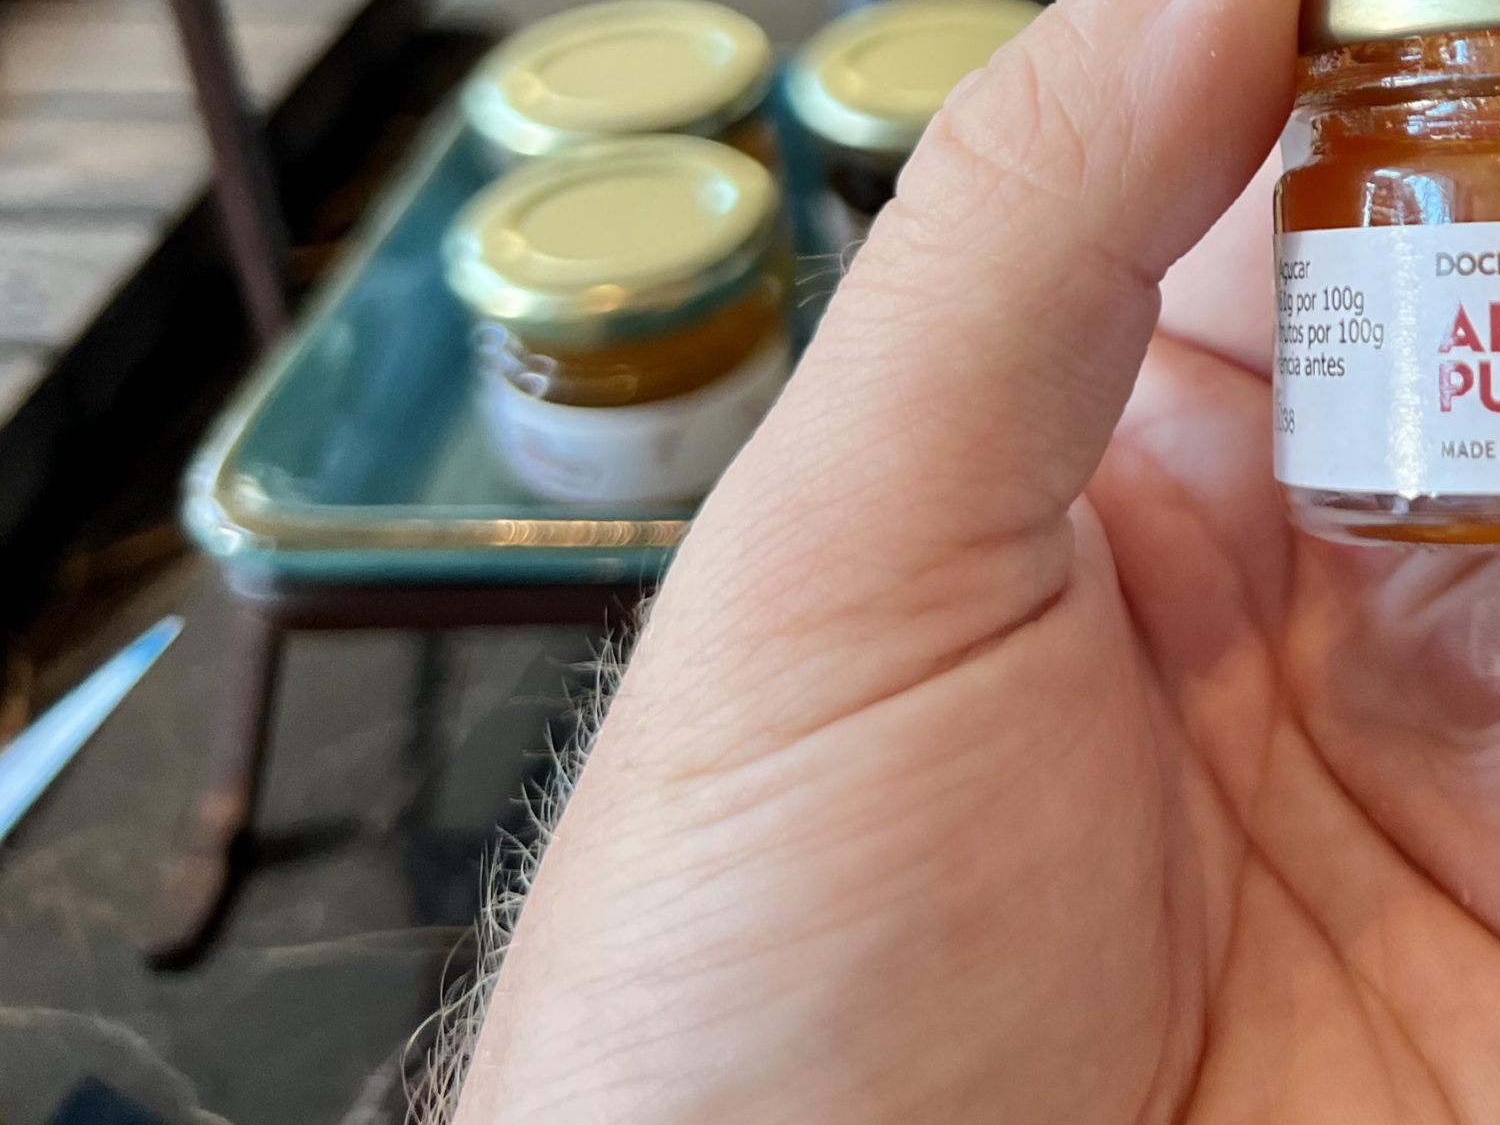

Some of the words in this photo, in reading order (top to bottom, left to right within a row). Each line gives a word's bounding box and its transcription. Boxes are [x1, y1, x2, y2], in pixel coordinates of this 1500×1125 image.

[1297, 292, 1317, 317] por
[1323, 285, 1365, 316] 100g
[1308, 324, 1332, 349] por
[1339, 317, 1385, 349] 100g
[1305, 353, 1346, 377] antes
[1440, 440, 1497, 459] MADE
